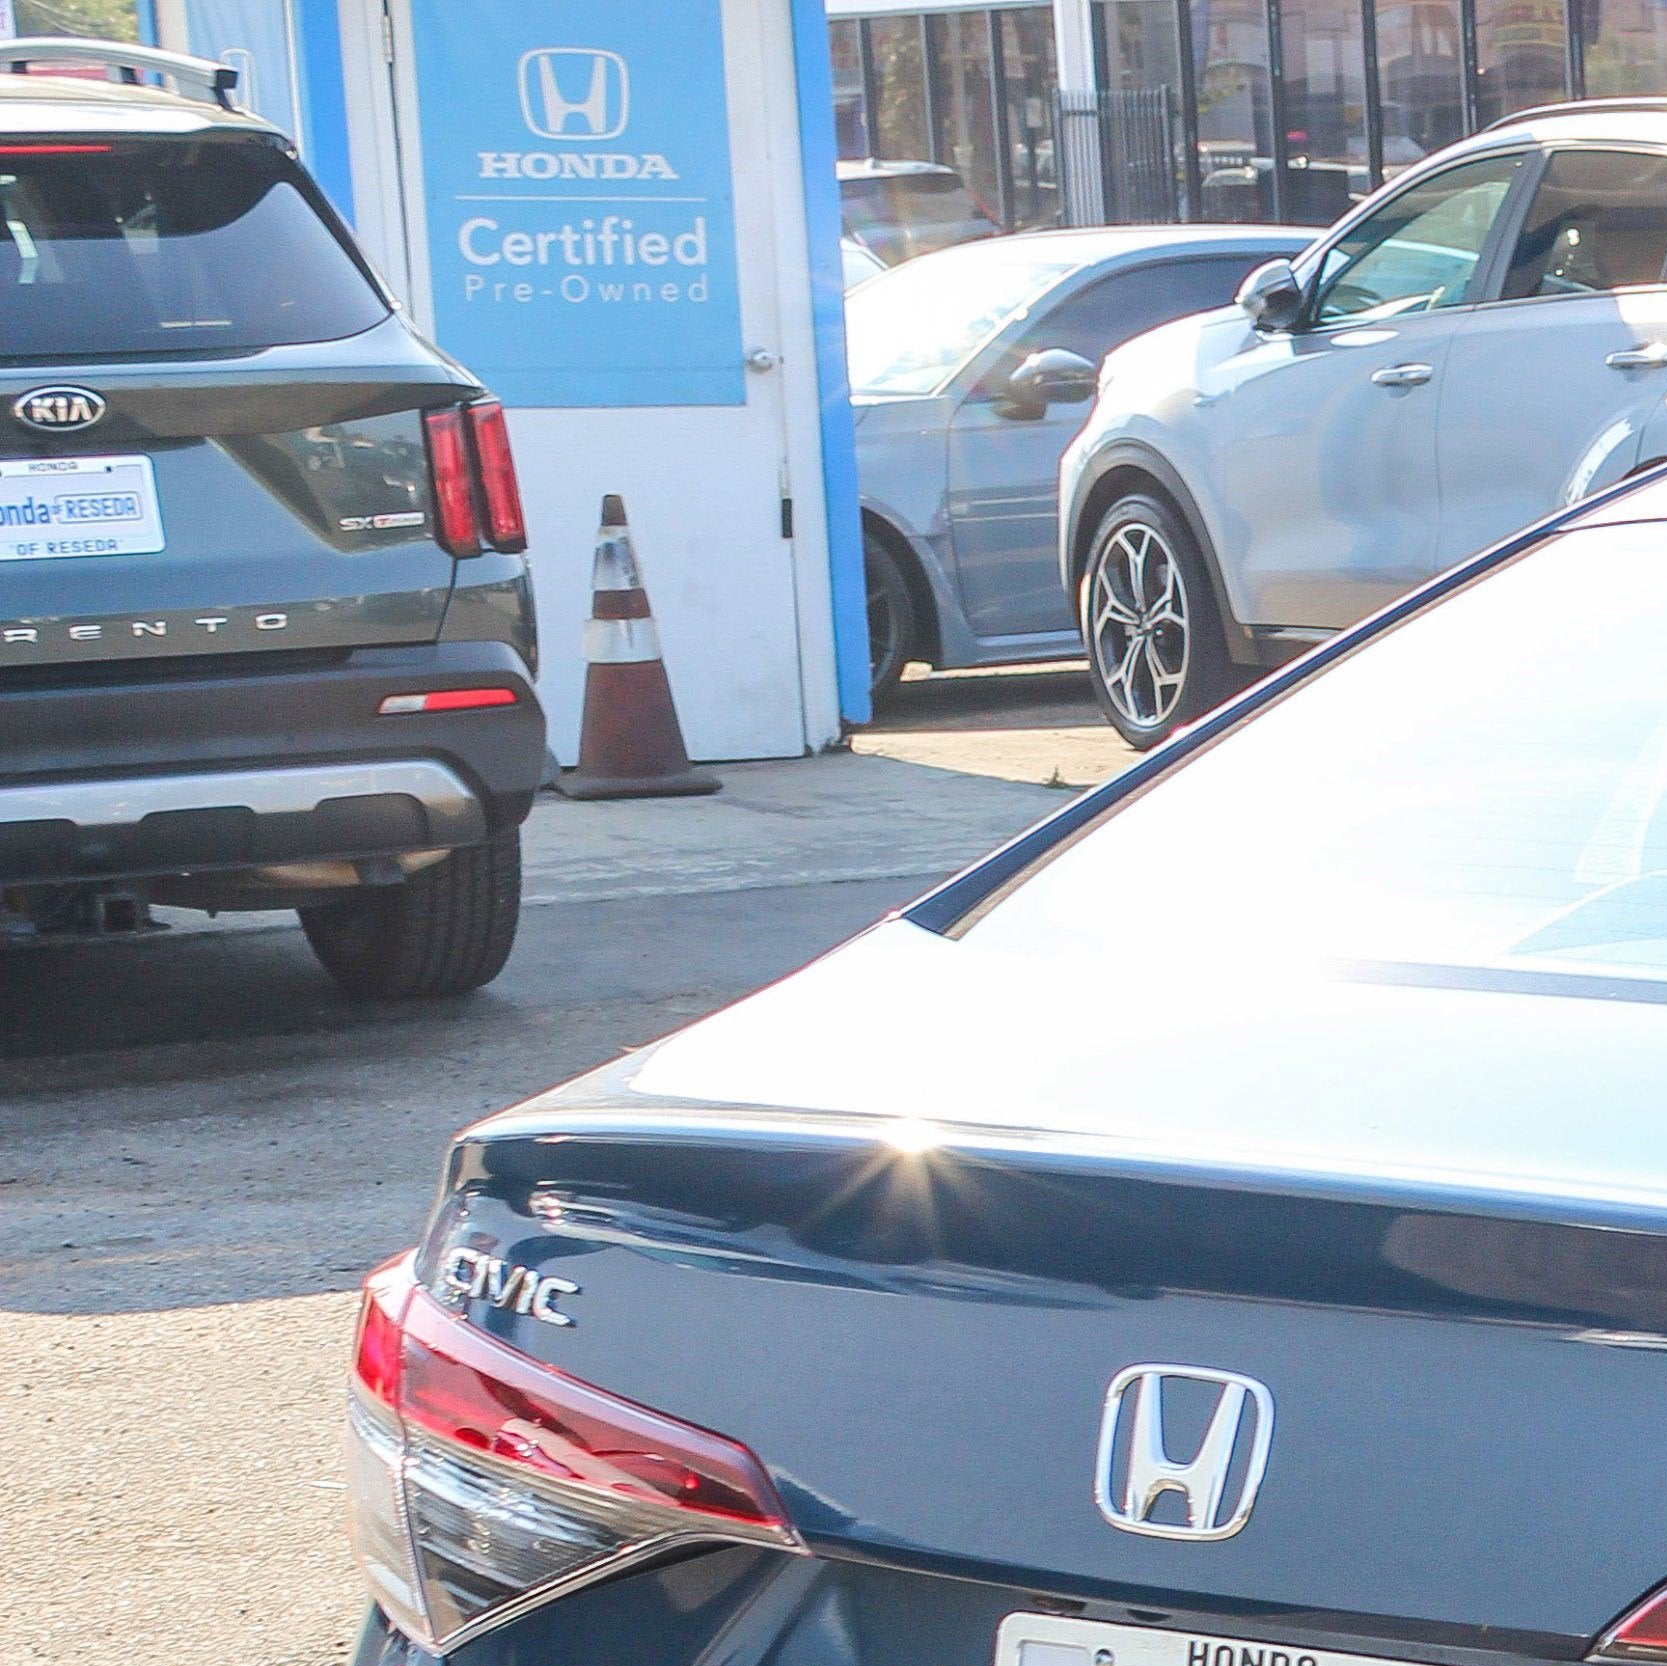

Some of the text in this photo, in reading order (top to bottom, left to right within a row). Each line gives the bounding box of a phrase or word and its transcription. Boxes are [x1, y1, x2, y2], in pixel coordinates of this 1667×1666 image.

[477, 151, 680, 181] HONDA
[457, 216, 709, 267] Certified
[464, 273, 709, 303] Pre-Owned
[30, 395, 95, 423] KIA
[66, 496, 137, 519] RESEDA
[15, 538, 119, 557] OF RESEDA
[442, 1246, 581, 1327] CIVIC
